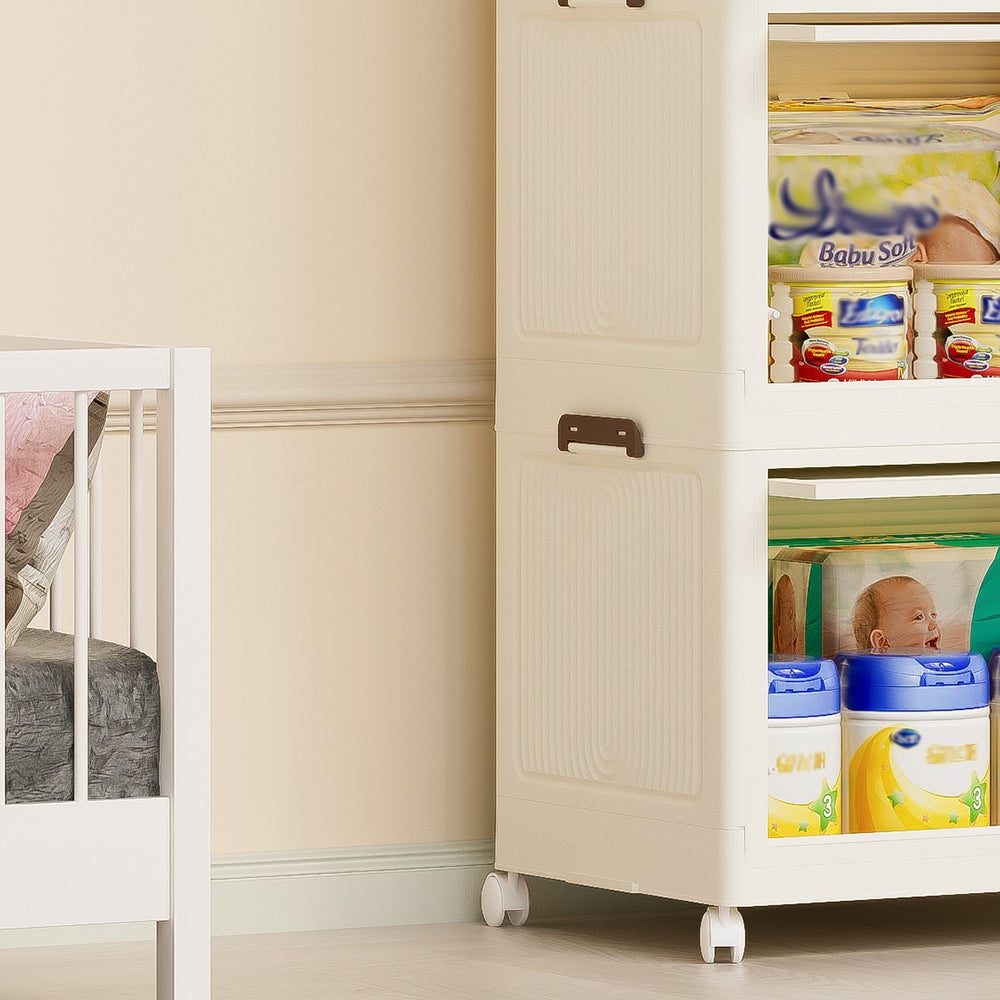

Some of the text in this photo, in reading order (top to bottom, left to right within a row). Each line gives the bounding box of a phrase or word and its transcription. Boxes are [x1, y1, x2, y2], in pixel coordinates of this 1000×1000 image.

[878, 235, 916, 261] Soft
[823, 795, 832, 818] 3
[973, 787, 983, 810] 3
